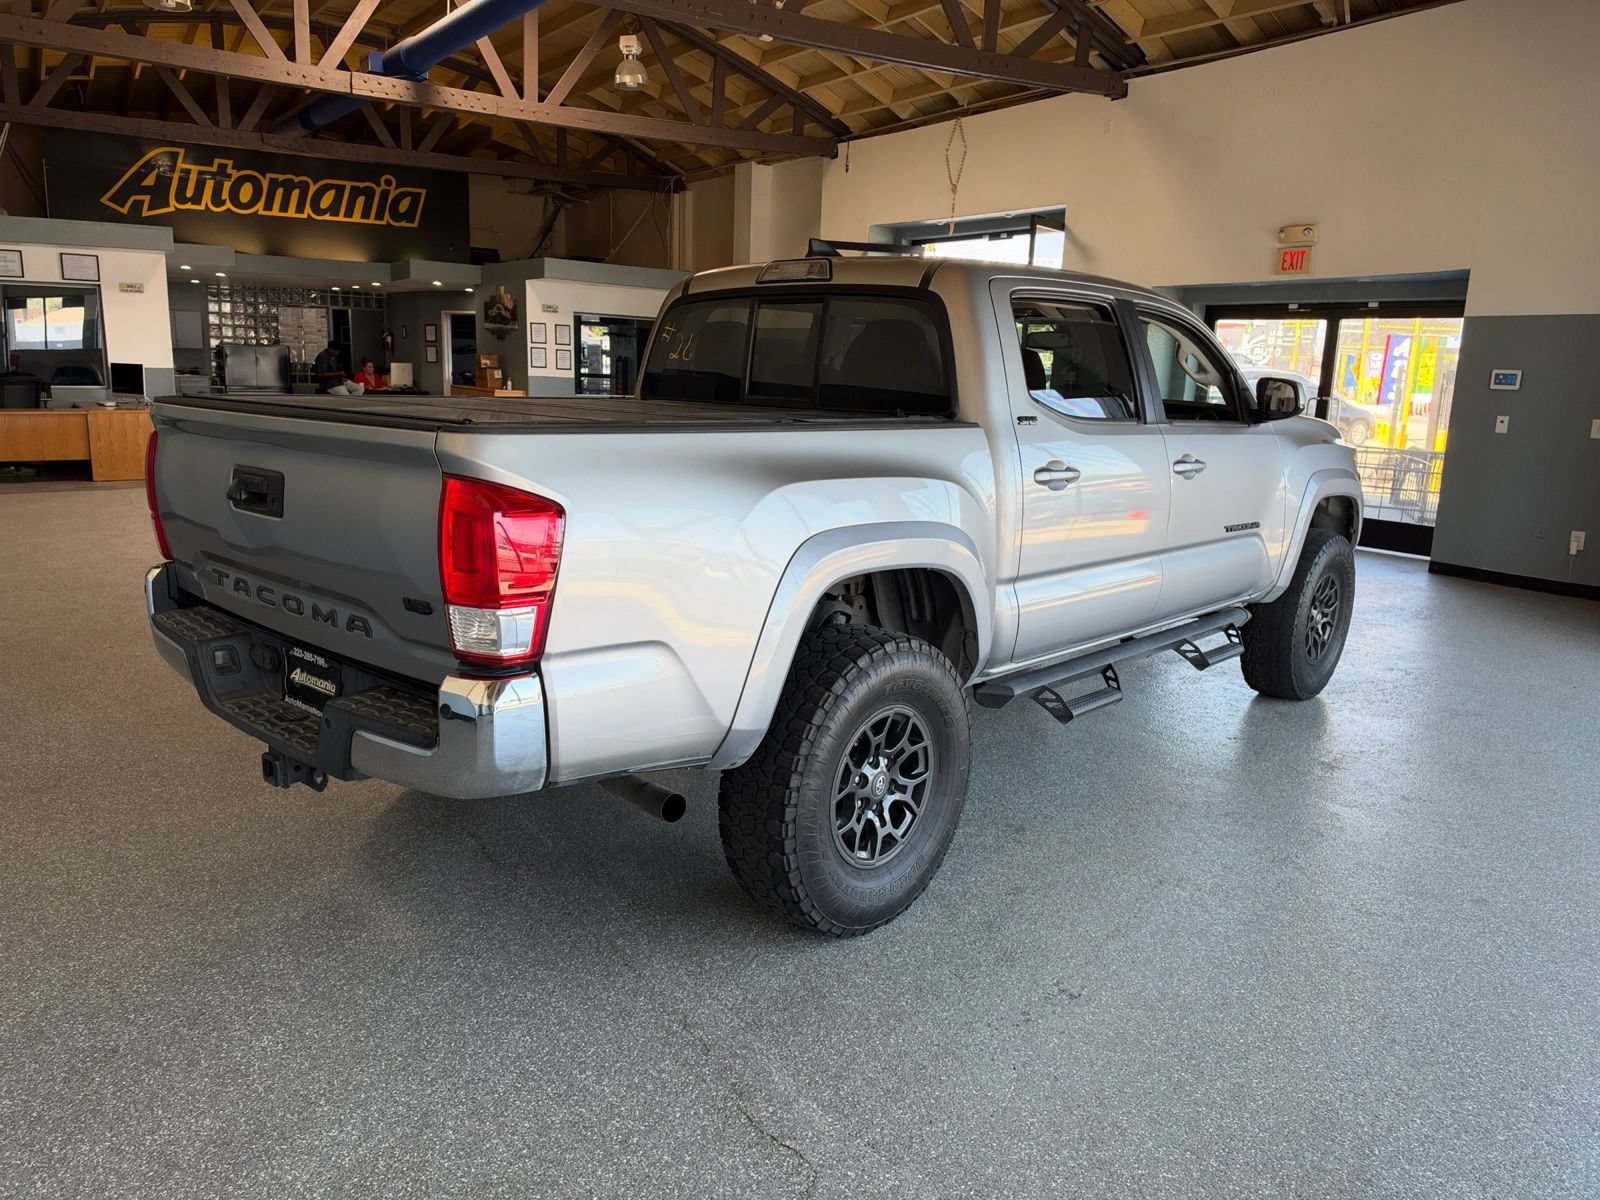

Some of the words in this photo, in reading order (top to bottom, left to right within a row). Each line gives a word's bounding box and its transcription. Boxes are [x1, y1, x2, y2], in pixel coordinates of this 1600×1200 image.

[100, 146, 427, 228] Automania
[1281, 250, 1307, 271] EXIT
[211, 567, 373, 639] TACOMA
[290, 667, 336, 693] Automania
